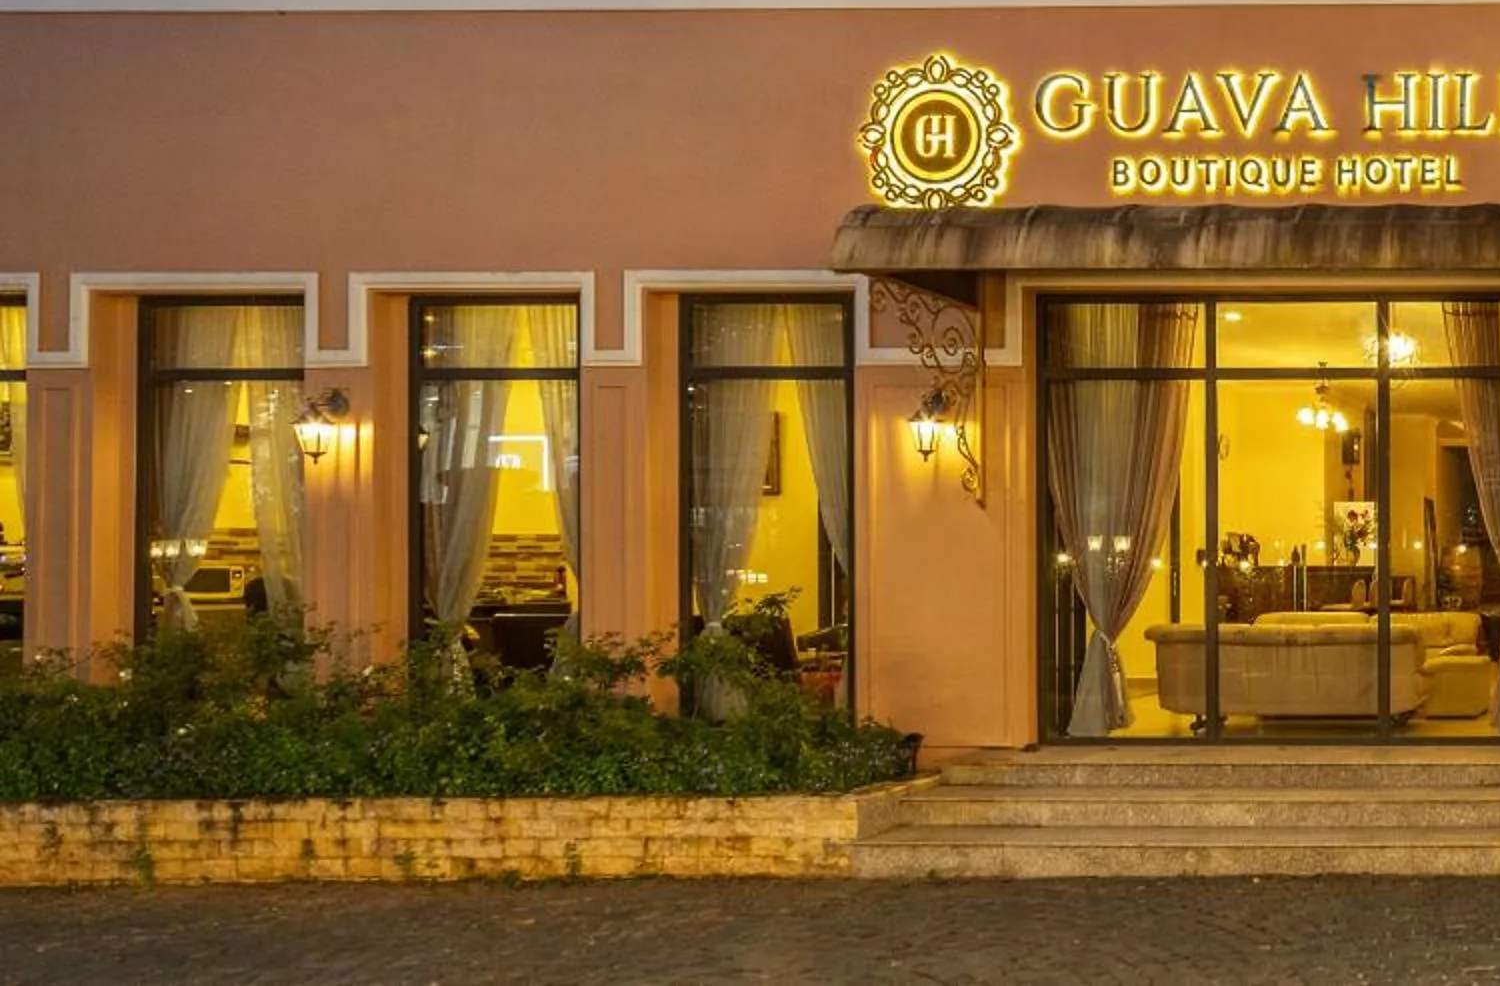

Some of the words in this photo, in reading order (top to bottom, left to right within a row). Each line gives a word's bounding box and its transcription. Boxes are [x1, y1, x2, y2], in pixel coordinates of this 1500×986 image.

[1034, 72, 1330, 134] GUAVA
[1112, 157, 1320, 191] BOUTIQUE
[1336, 157, 1463, 189] HOTEL
